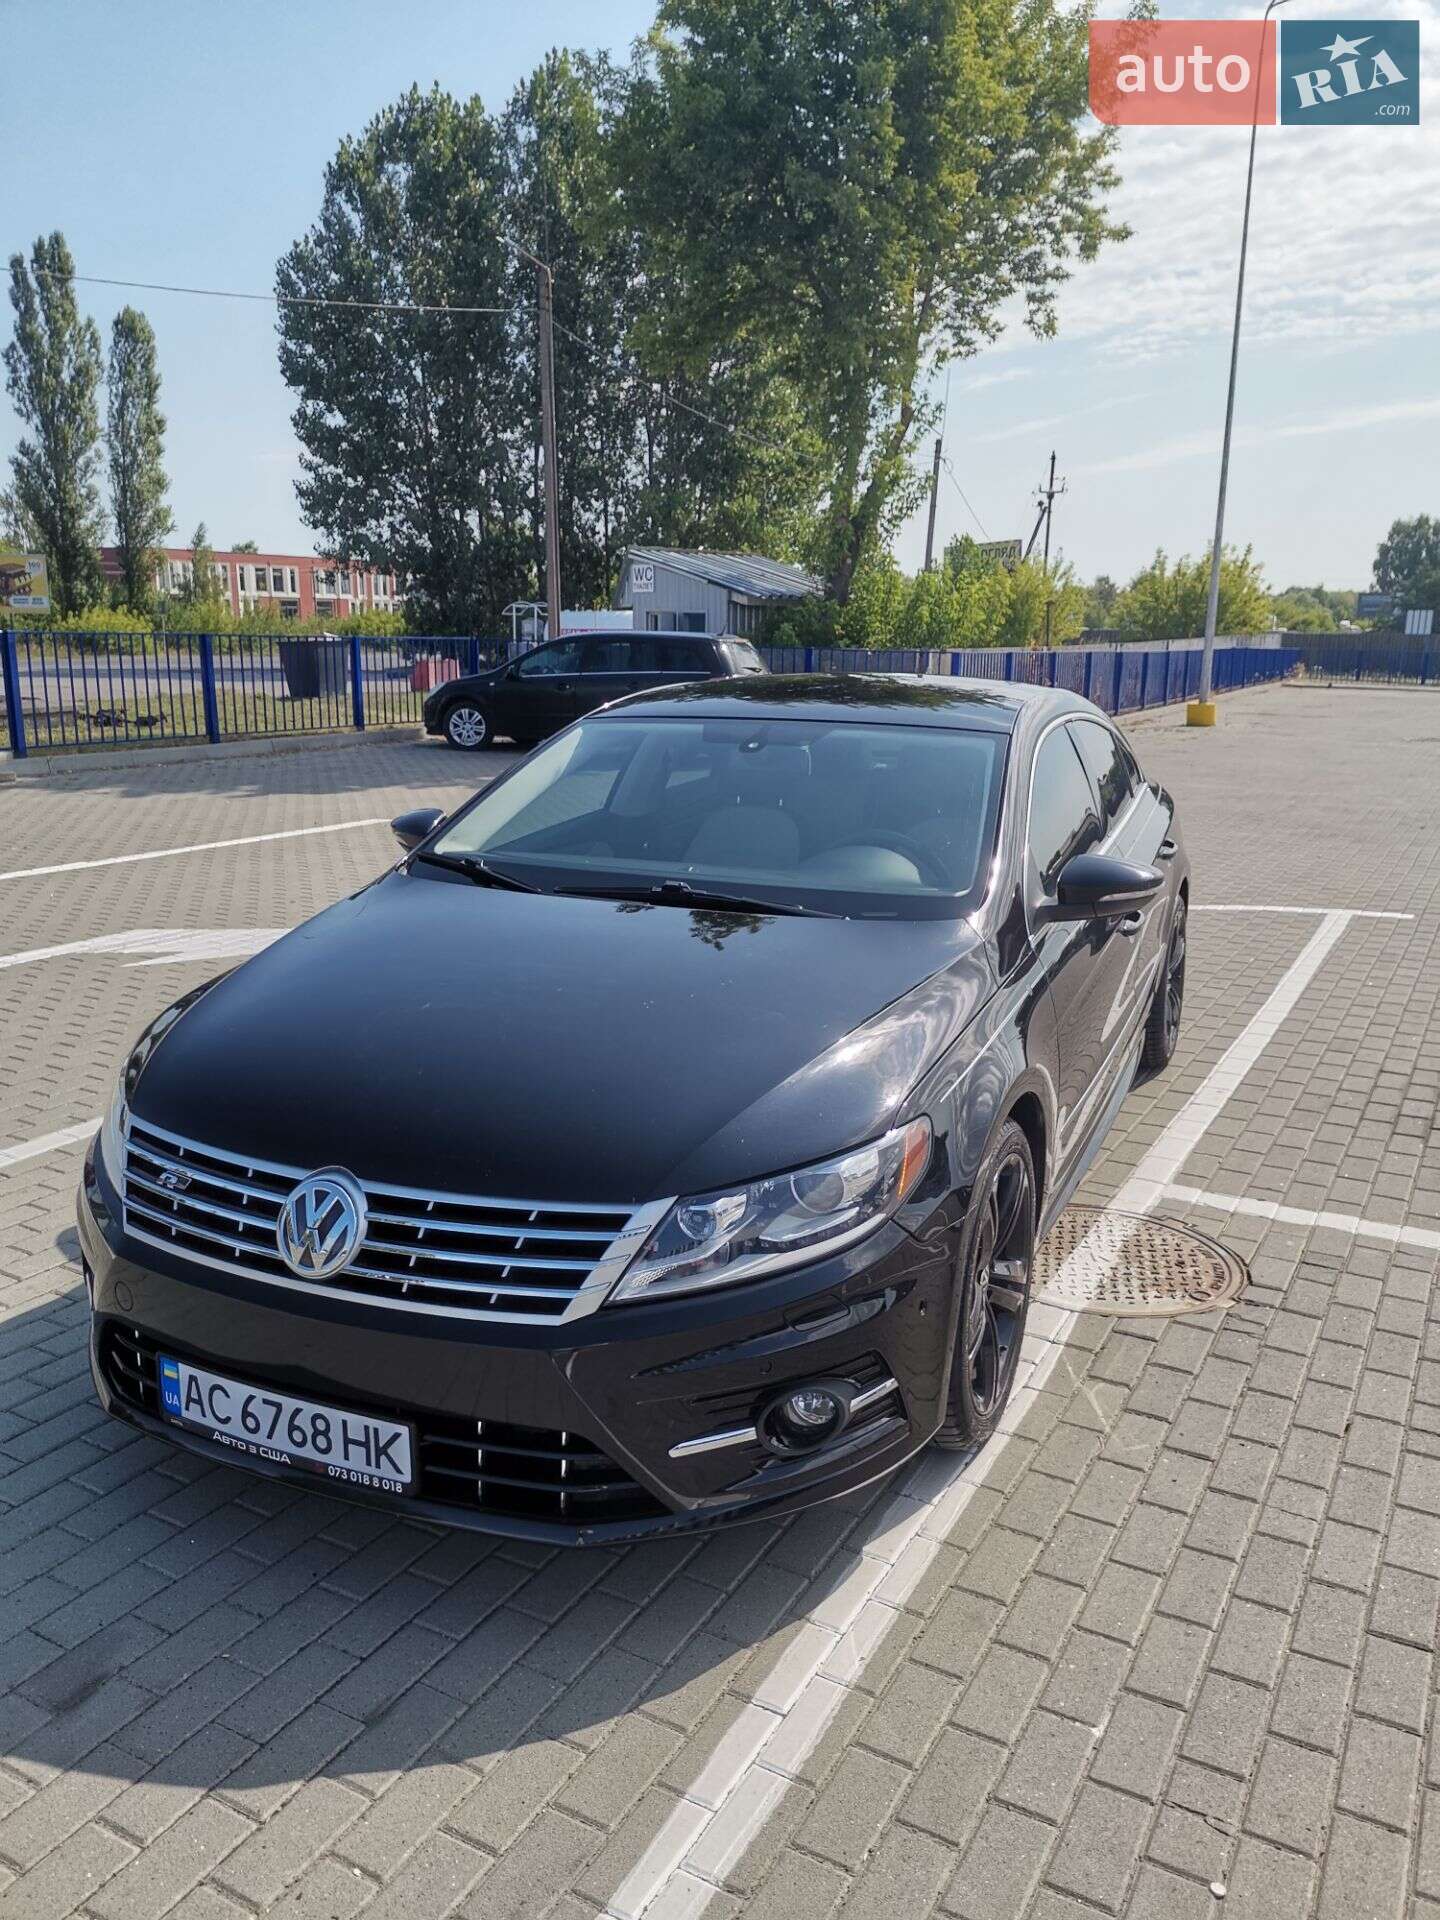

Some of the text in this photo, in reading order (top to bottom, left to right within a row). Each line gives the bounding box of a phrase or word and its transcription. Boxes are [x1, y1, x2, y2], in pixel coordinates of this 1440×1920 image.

[634, 567, 653, 581] WC
[165, 1391, 181, 1407] UA
[184, 1374, 404, 1475] AC 6768 HK
[259, 1447, 292, 1465] США
[327, 1466, 403, 1493] 073 018 8 018
